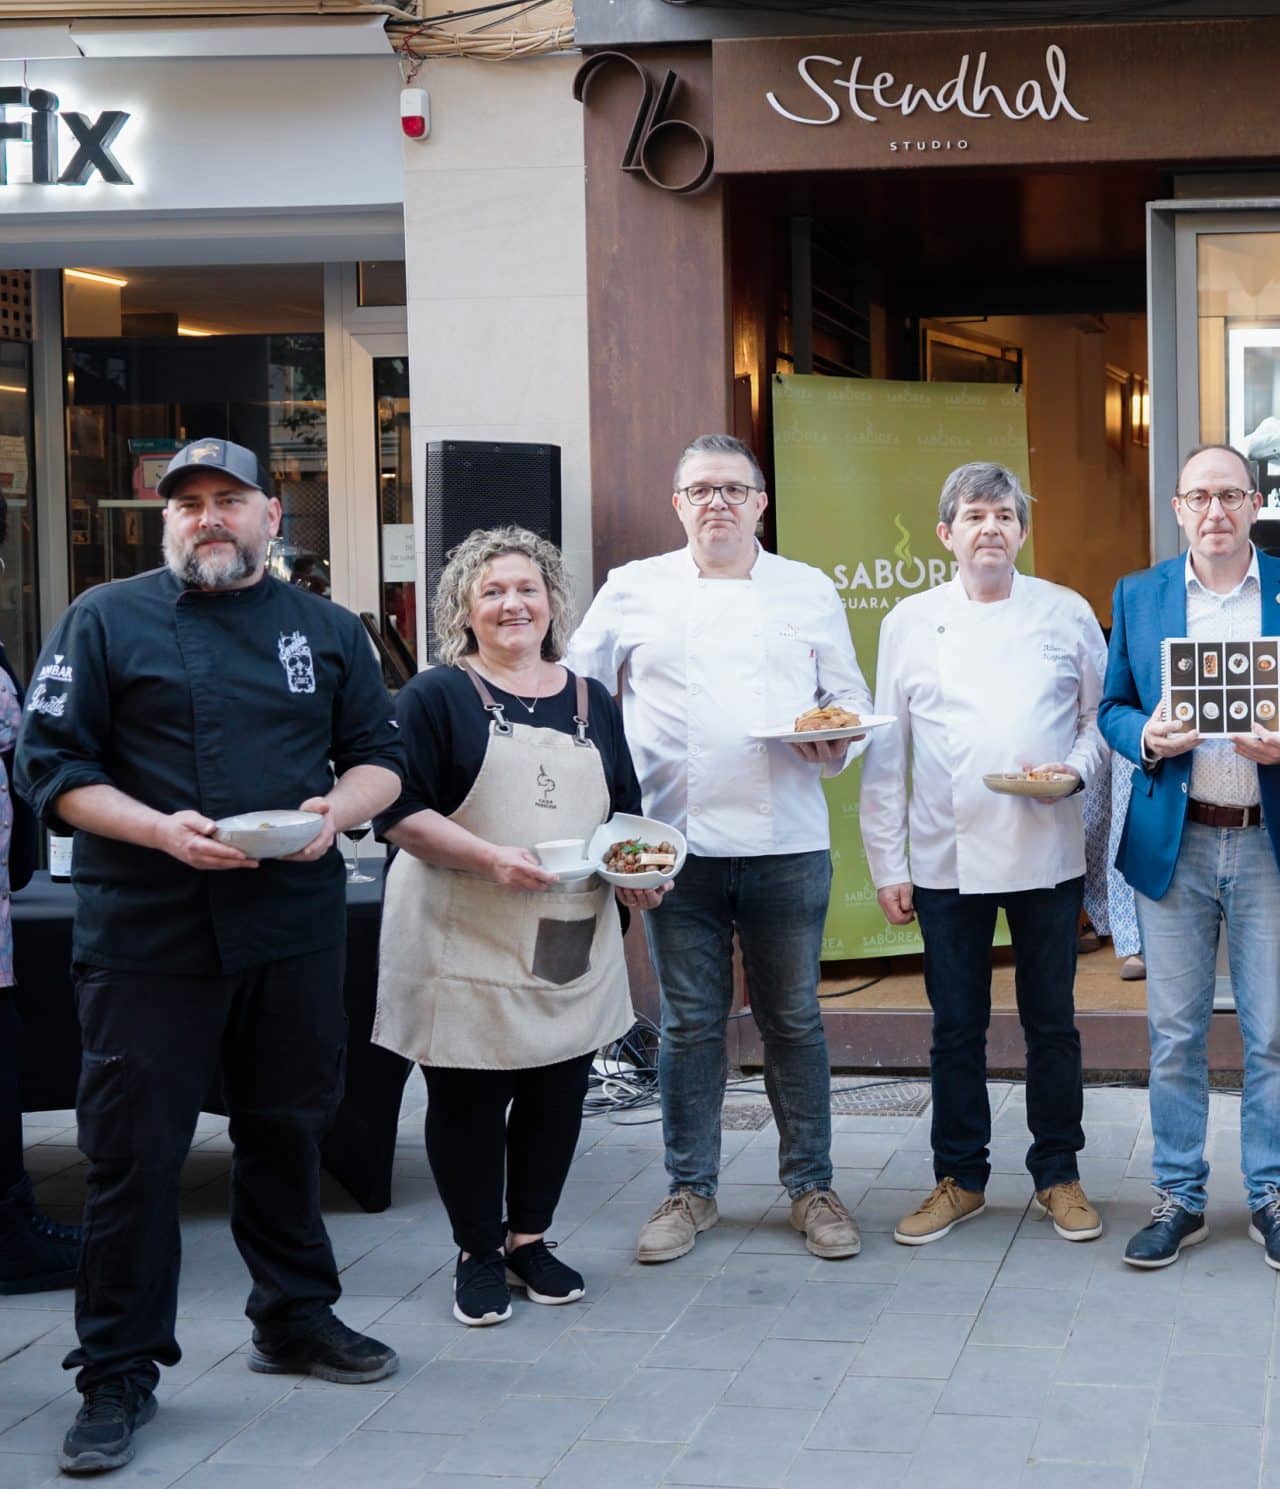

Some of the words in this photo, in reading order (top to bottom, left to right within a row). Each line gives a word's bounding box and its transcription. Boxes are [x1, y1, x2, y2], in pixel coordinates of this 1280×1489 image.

[573, 51, 714, 194] 26
[766, 44, 1090, 125] Stendhal
[889, 139, 969, 152] STUDIO
